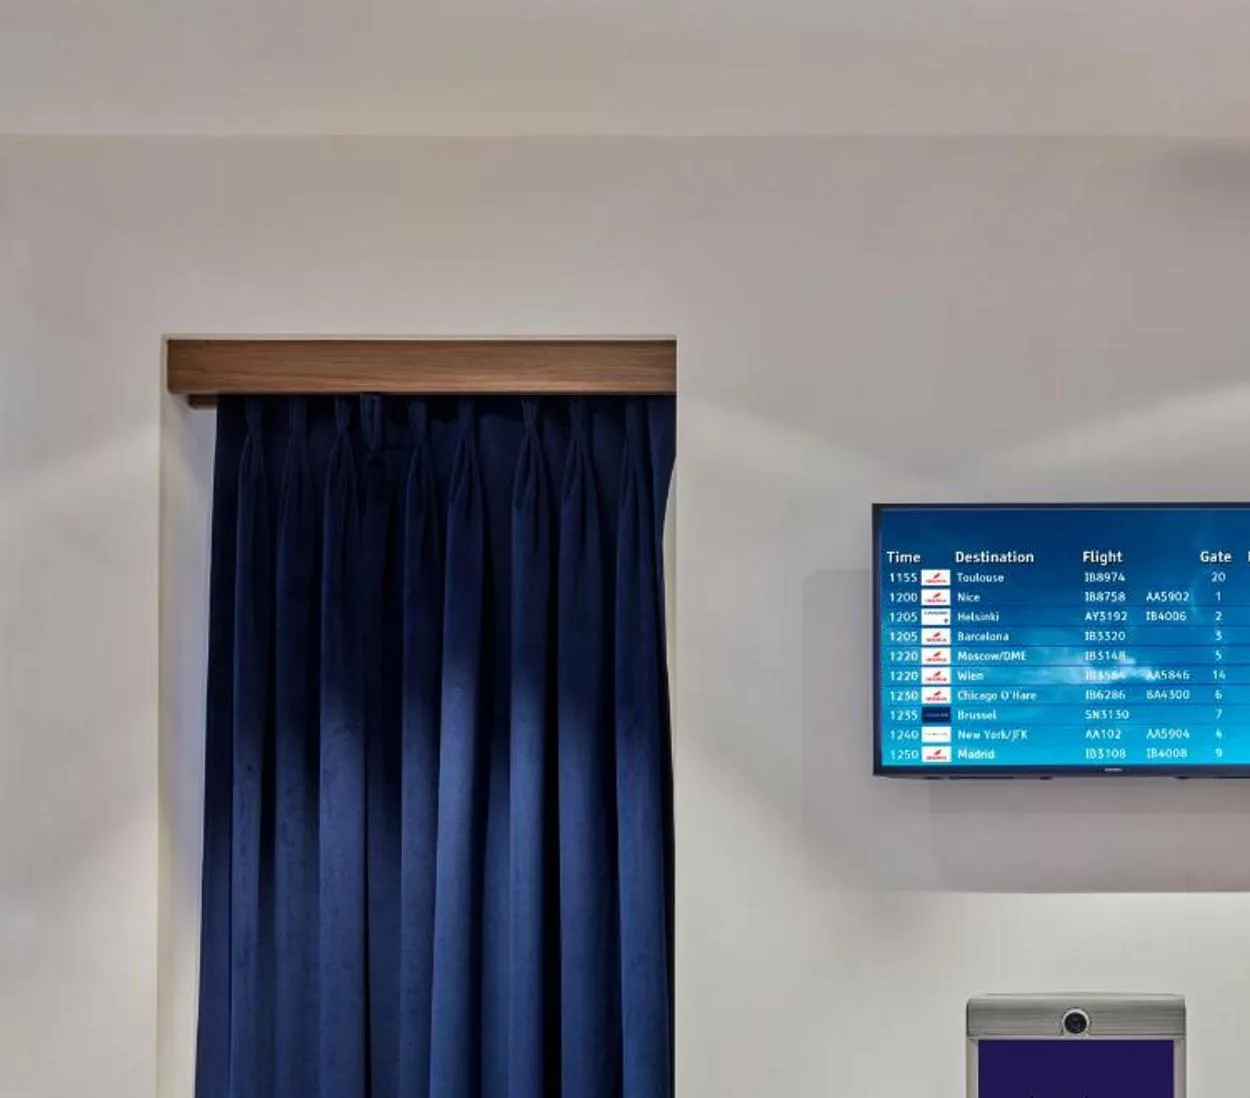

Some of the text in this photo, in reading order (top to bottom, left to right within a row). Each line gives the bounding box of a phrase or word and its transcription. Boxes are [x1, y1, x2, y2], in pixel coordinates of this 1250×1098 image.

[887, 552, 921, 563] Time
[956, 552, 1034, 563] Destination
[1083, 551, 1123, 565] Flight
[1200, 552, 1232, 563] Gate
[889, 573, 1226, 583] 1155 Toulouse IB8974 20
[889, 592, 1221, 602] 1200 Nice IB8758 AA5902 1
[890, 612, 918, 622] 1205
[958, 612, 999, 622] Helsinki
[1084, 612, 1127, 622] AY3192
[1146, 612, 1186, 622] IB4006
[1216, 612, 1222, 622] 2
[890, 631, 1222, 641] 1205 Barcelona IB3320 3
[890, 651, 918, 661] 1220
[958, 651, 1026, 661] Moscow/DME
[1216, 651, 1222, 661] 5
[890, 671, 918, 681] 1220
[958, 671, 983, 681] Wien
[1146, 671, 1190, 681] AA5846
[890, 690, 918, 700] 1230
[958, 690, 997, 702] Chicago
[1001, 690, 1036, 700] O'Hare
[1084, 690, 1126, 700] IB6286
[1216, 690, 1222, 700] 6
[958, 710, 996, 720] Brussel
[1084, 710, 1130, 720] SN3130
[1216, 710, 1222, 720] 7
[890, 729, 919, 739] 1240
[958, 729, 981, 739] New
[984, 729, 1027, 741] York/JFK
[1084, 729, 1121, 739] AA102
[890, 749, 919, 759] 1250
[958, 749, 995, 759] Madrid
[1084, 749, 1126, 759] IB3108
[1146, 749, 1188, 759] IB4008
